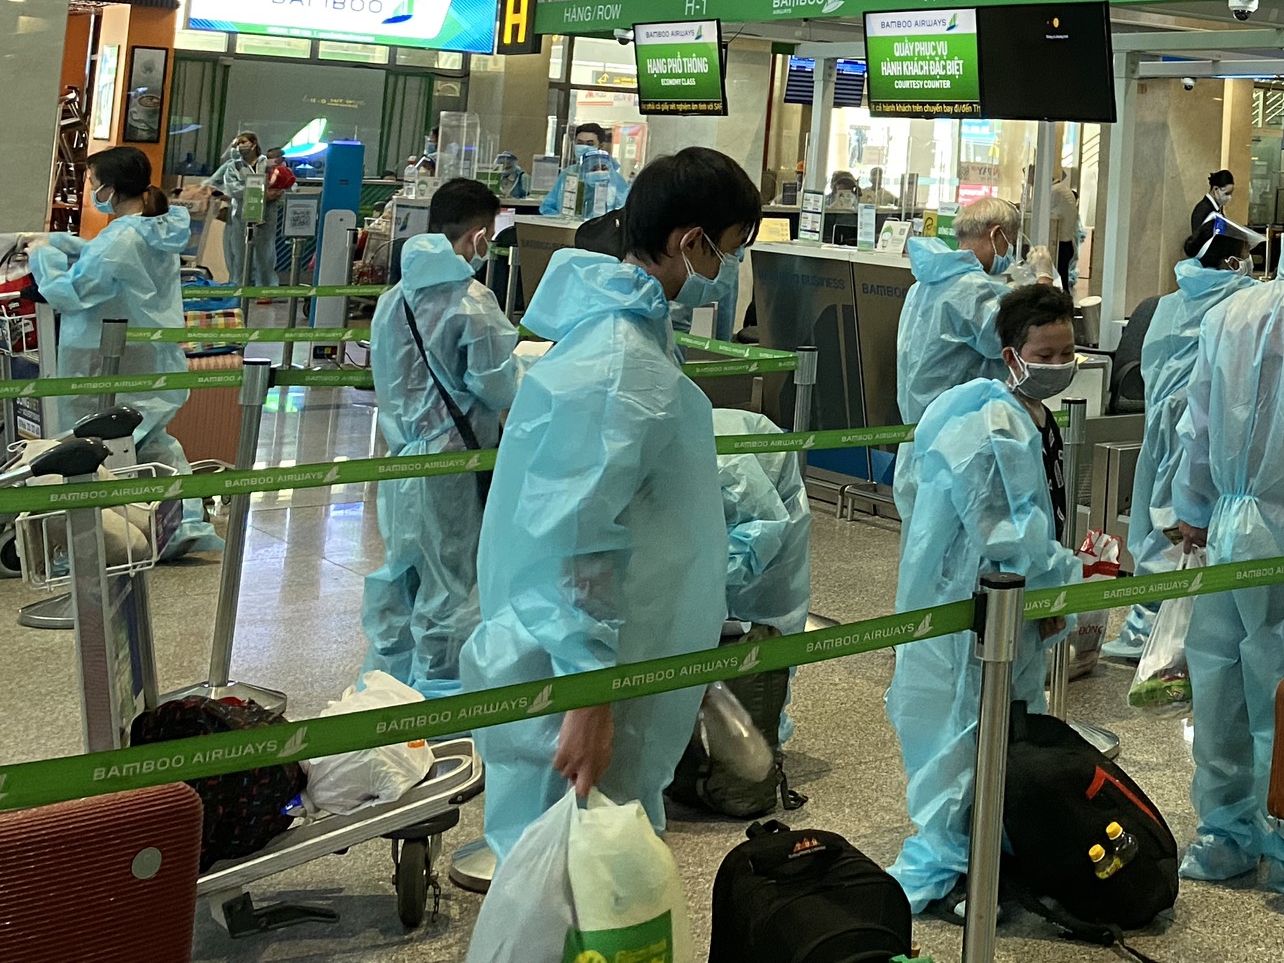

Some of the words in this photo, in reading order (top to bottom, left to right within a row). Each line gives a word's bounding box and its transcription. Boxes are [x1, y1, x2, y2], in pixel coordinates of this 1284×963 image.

[563, 3, 622, 23] HÀNG/ROW
[880, 20, 913, 29] BAMBOO
[914, 18, 947, 28] AIRWAYS
[670, 29, 695, 38] AIRWAYS
[893, 37, 915, 57] QUẦY
[915, 41, 937, 57] PHỤC
[937, 41, 948, 61] VỤ
[647, 58, 667, 78] HẠNG
[667, 52, 682, 74] PHỔ
[682, 54, 708, 74] THÔNG
[881, 58, 902, 76] HÀNH
[903, 56, 929, 75] KHÁCH
[929, 57, 946, 79] ĐẶC
[946, 55, 964, 79] BIỆT
[661, 78, 681, 86] ECONOMY
[681, 78, 696, 86] CLASS
[894, 80, 923, 89] COURTESY
[923, 80, 951, 89] COUNTER
[71, 381, 112, 389] BAMBOO
[114, 379, 152, 387] AIRWAYS
[769, 438, 803, 447] AIRWAYS
[378, 462, 422, 473] BAMBOO
[423, 458, 466, 470] AIRWAYS
[224, 475, 274, 488] BAMBOO
[277, 471, 323, 483] AIRWAYS
[50, 490, 107, 503] BAMBOO
[110, 485, 165, 497] AIRWAYS
[1236, 567, 1274, 580] BAMBOO
[1103, 585, 1147, 599] BAMBOO
[1148, 579, 1190, 595] AIRWAYS
[806, 634, 860, 653] BAMBOO
[863, 623, 915, 642] AIRWAYS
[611, 668, 676, 691] BAMBOO
[680, 656, 739, 677] AIRWAYS
[376, 709, 452, 734] BAMBOO
[457, 696, 528, 721] AIRWAYS
[92, 754, 185, 782] BAMBOO
[191, 739, 278, 765] AIRWAYS
